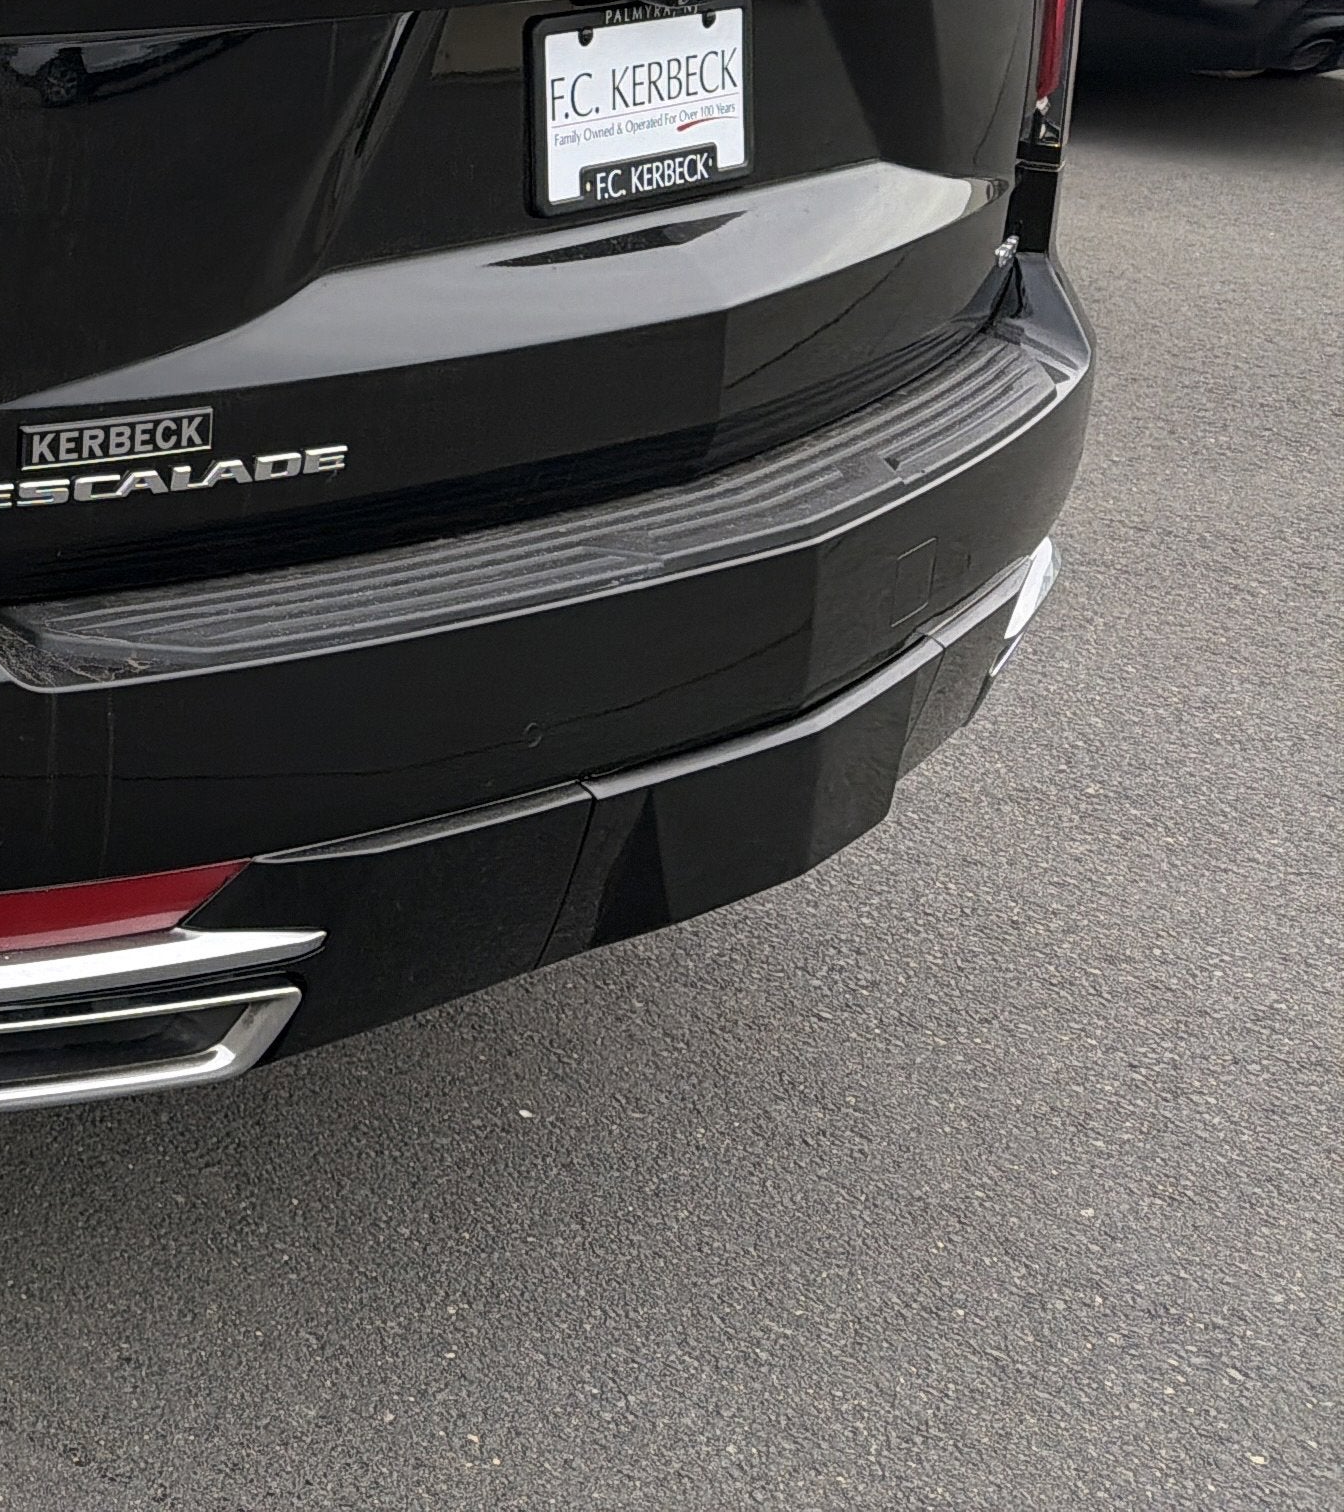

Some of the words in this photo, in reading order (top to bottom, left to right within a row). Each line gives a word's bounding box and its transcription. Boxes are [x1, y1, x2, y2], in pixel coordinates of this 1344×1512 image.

[550, 72, 600, 121] F.C.
[611, 47, 738, 111] KERBECK
[554, 130, 582, 147] Family
[583, 125, 614, 142] Owned
[616, 122, 624, 135] &
[625, 115, 663, 135] Operated
[664, 112, 677, 125] For
[679, 108, 698, 122] Over
[700, 105, 714, 118] 100
[716, 102, 736, 115] Years
[596, 170, 627, 200] F.C.
[630, 152, 709, 195] KERBECK
[30, 416, 204, 464] KERBECK
